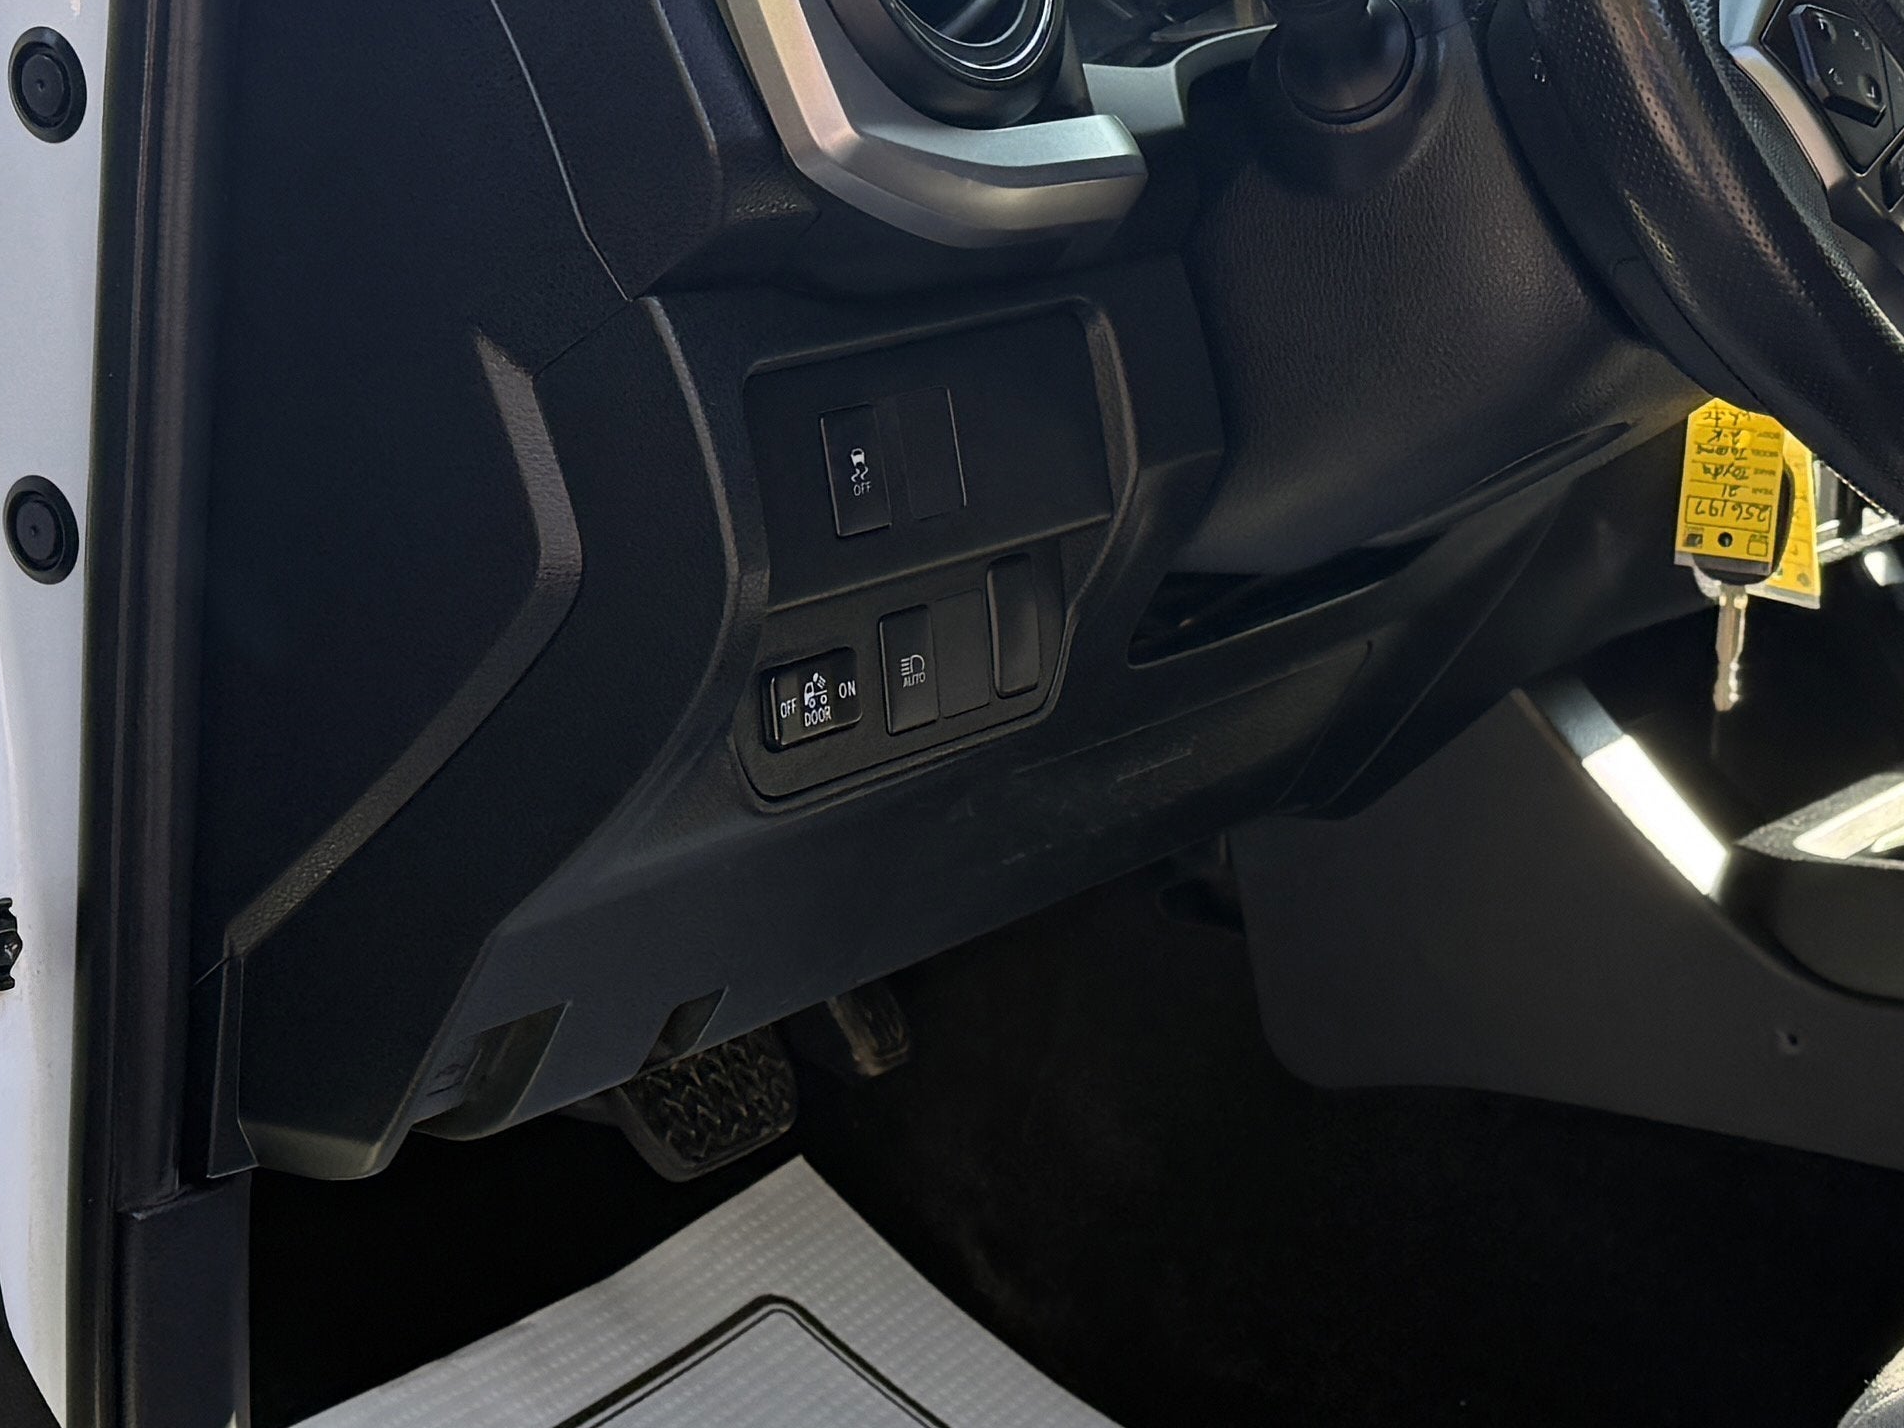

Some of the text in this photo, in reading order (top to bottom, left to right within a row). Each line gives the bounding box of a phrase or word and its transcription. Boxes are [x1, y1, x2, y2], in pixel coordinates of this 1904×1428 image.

[852, 481, 873, 497] OFF
[1695, 498, 1772, 522] 256197
[838, 680, 857, 700] ON
[902, 672, 927, 689] AUTO
[780, 695, 798, 719] OFF
[804, 705, 832, 728] DOOR
